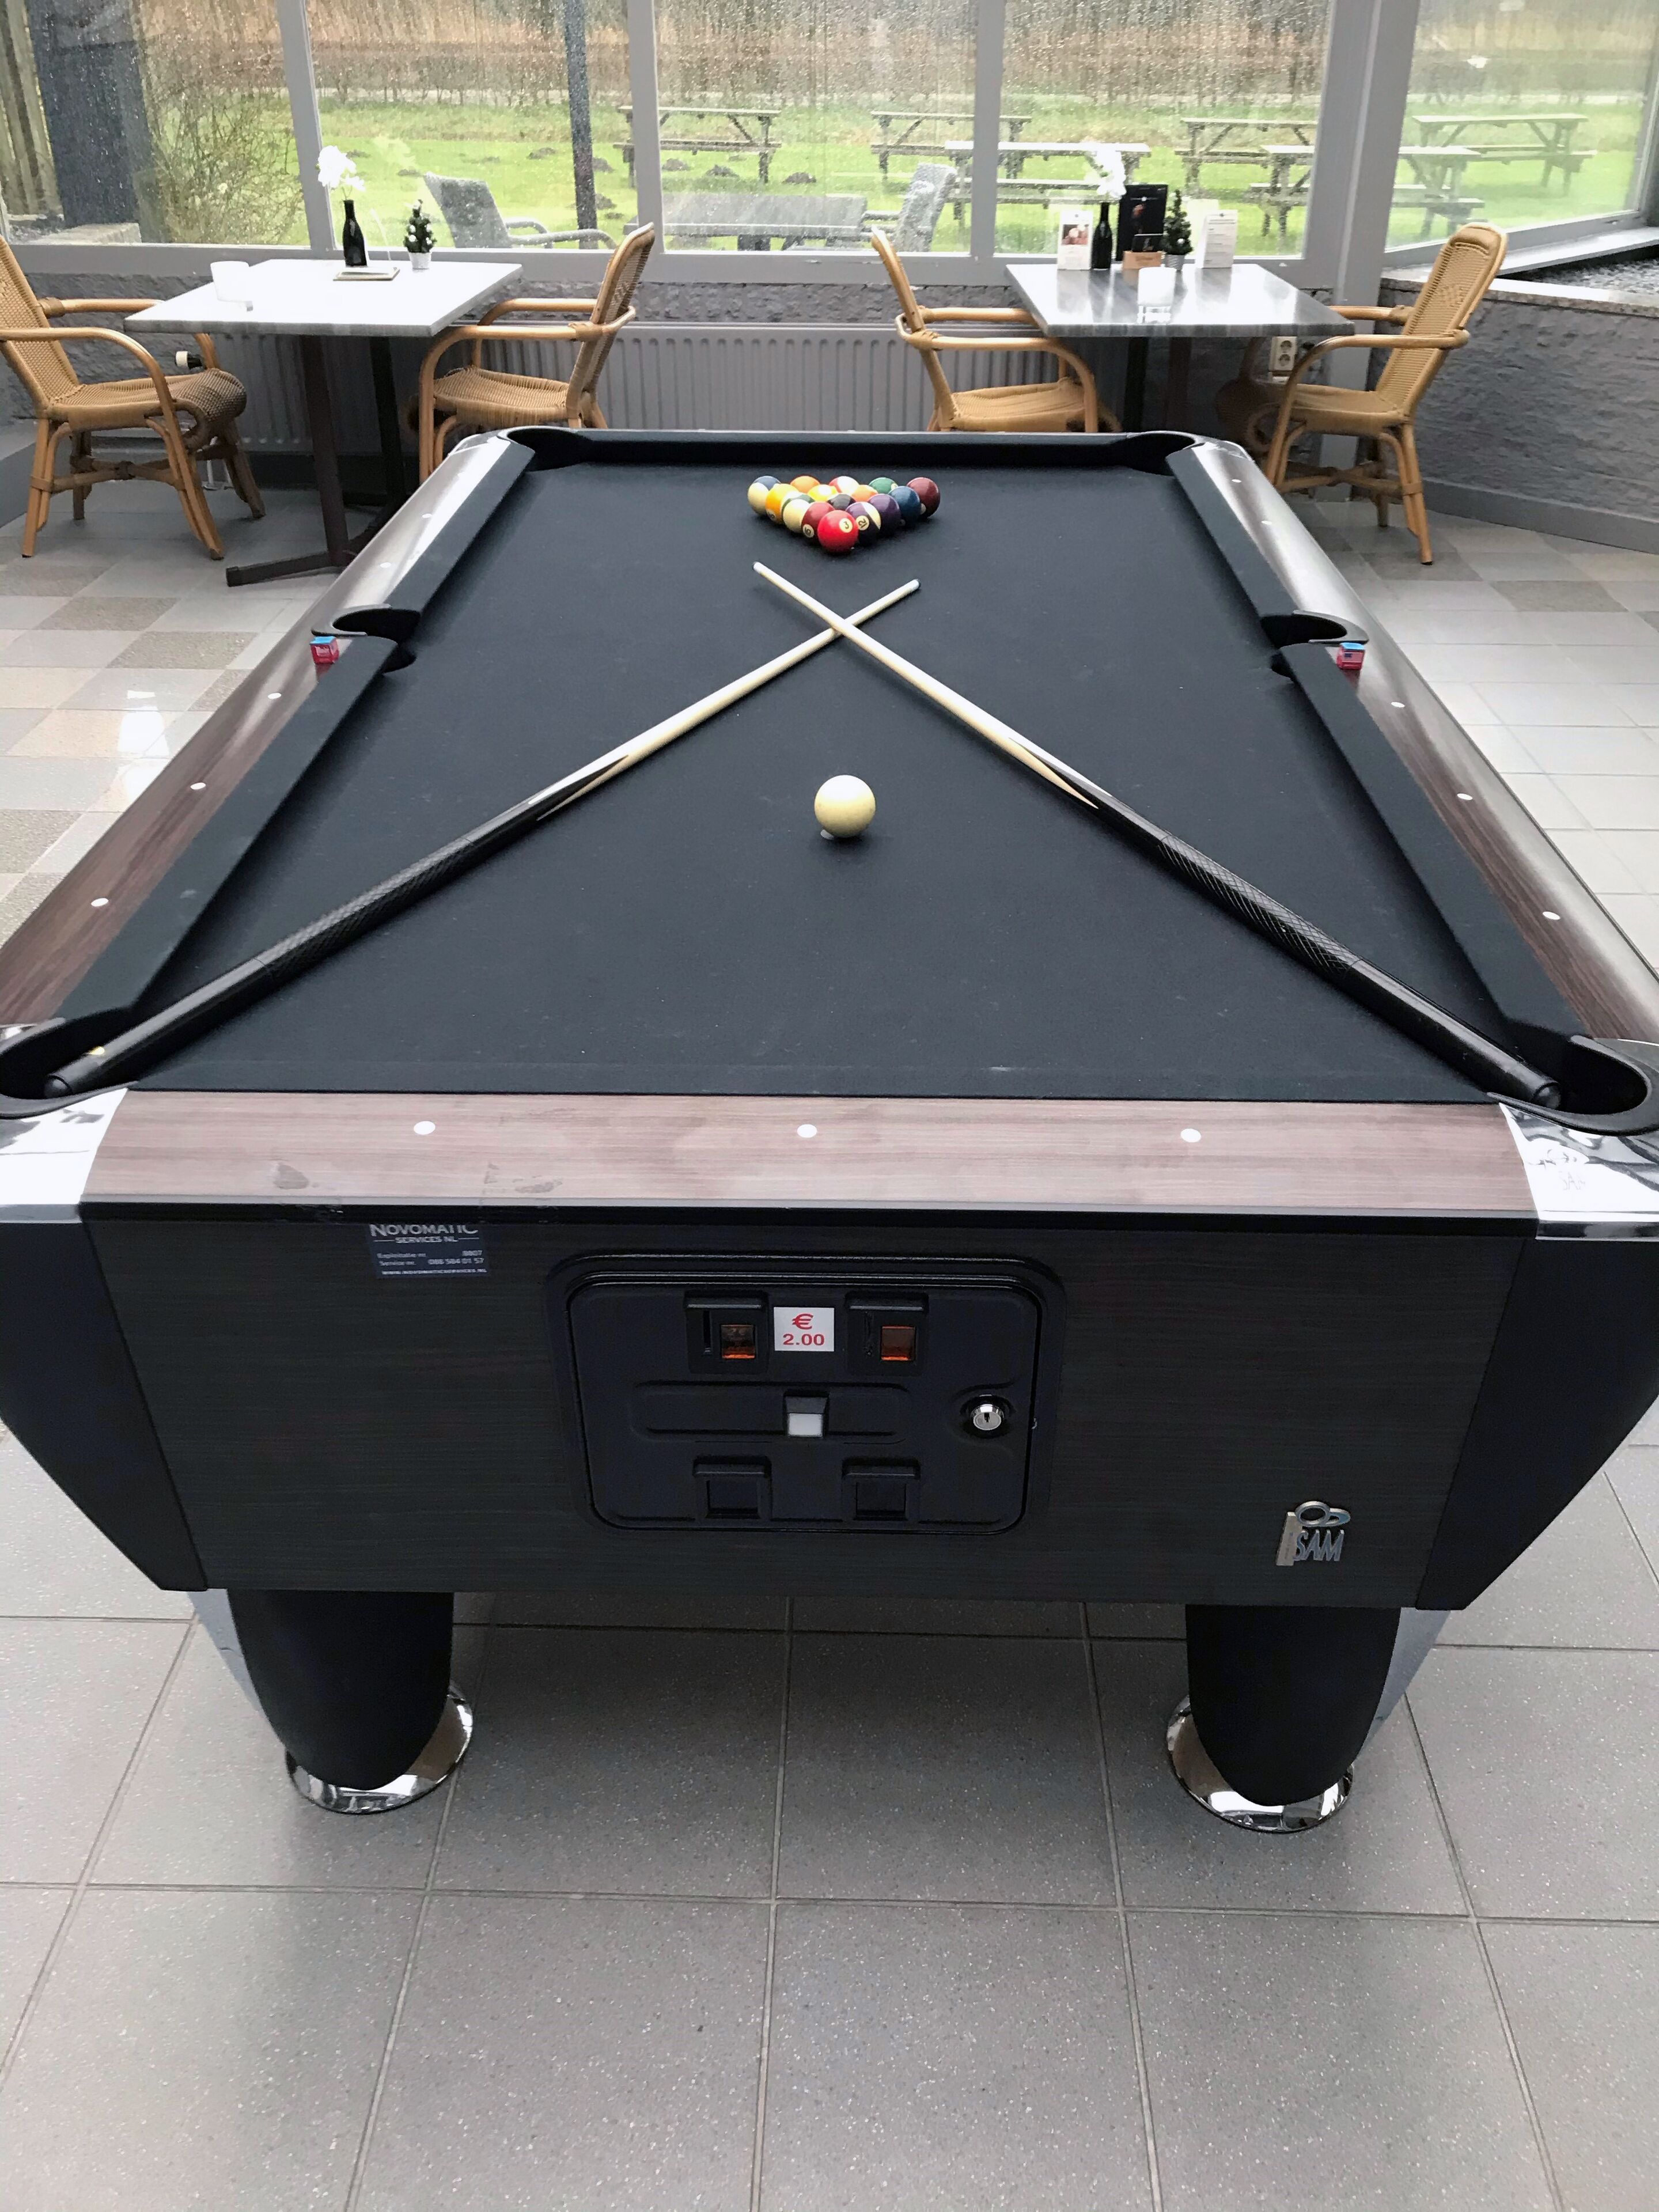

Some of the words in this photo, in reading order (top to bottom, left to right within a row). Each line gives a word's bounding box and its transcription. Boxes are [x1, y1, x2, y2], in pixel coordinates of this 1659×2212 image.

[843, 521, 850, 529] 3
[858, 518, 868, 528] 12
[791, 1313, 814, 1330] €
[782, 1333, 825, 1346] 2.00
[1294, 1529, 1344, 1561] SAM
